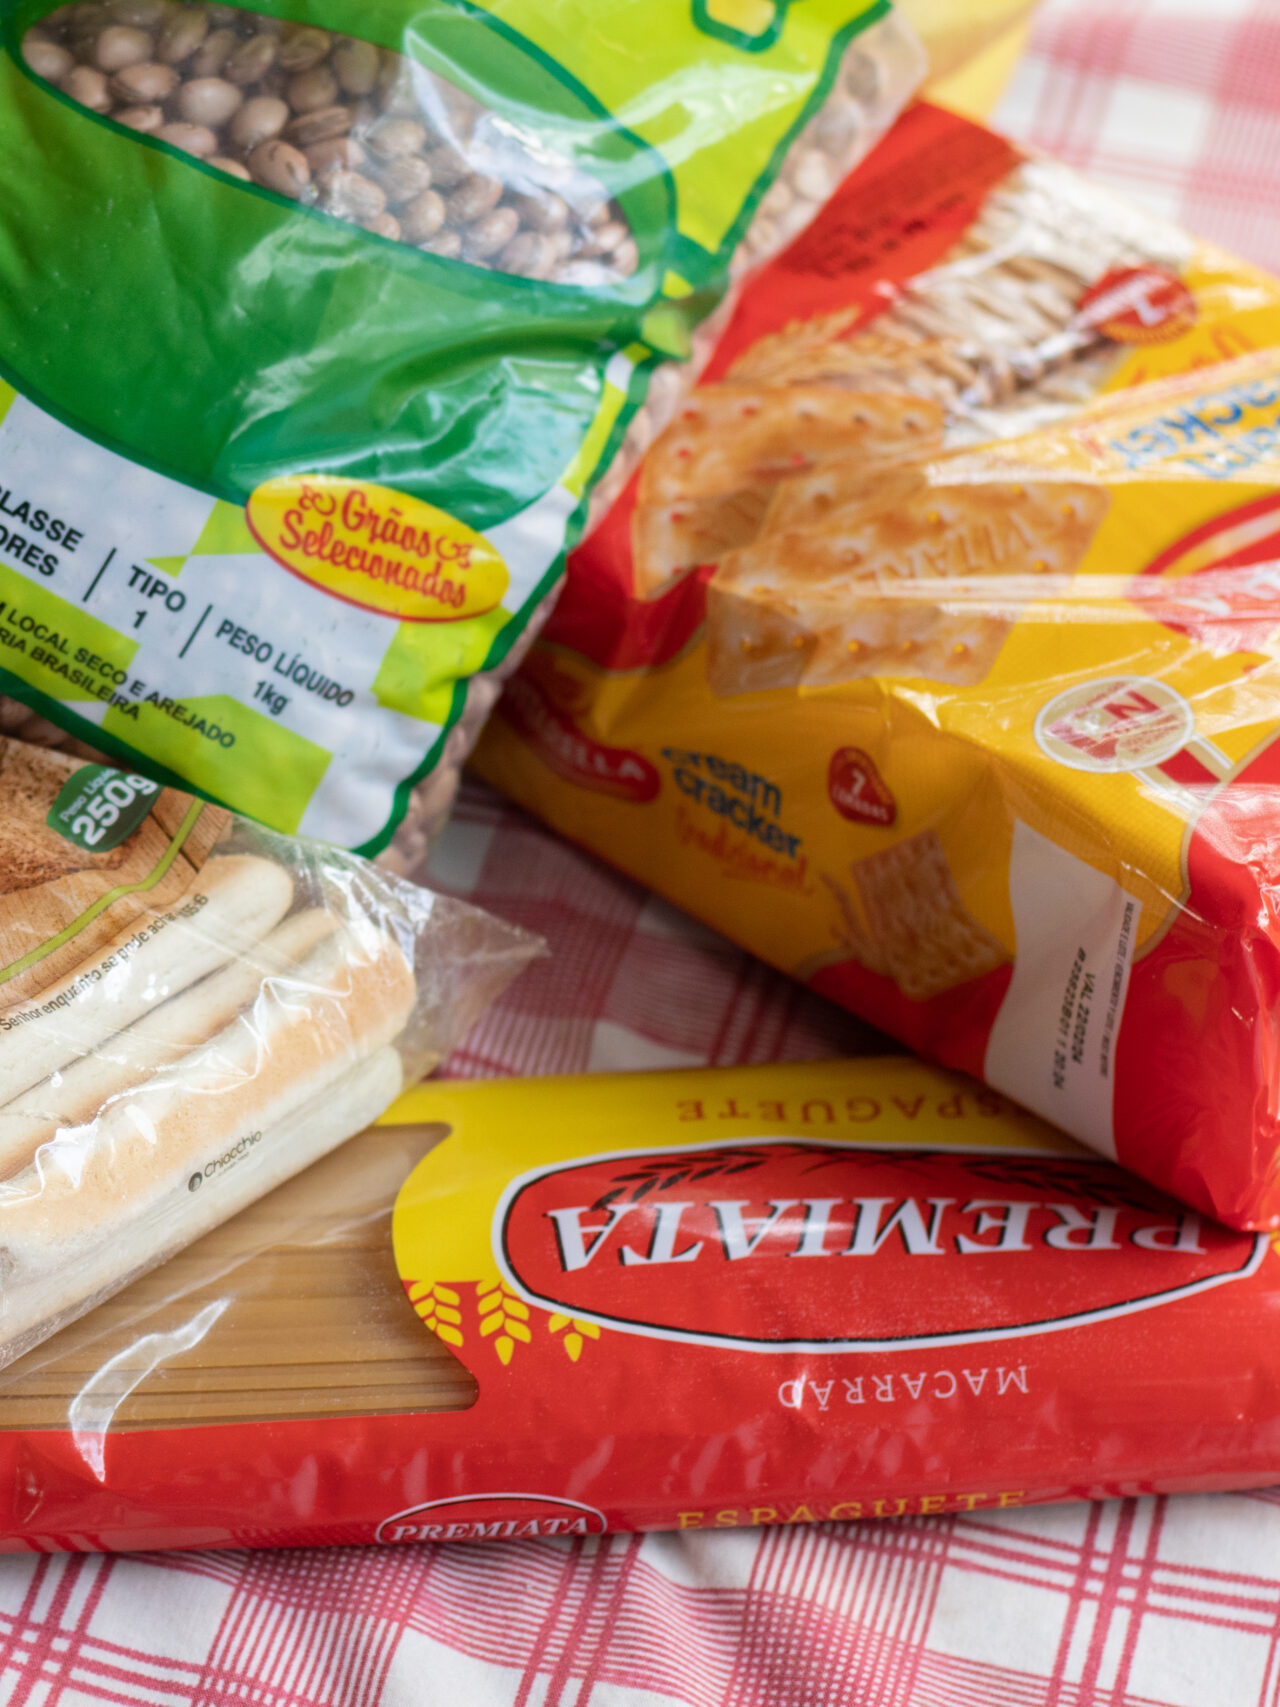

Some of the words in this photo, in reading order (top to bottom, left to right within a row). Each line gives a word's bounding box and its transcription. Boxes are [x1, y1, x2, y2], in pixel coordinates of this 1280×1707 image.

[341, 489, 431, 558] Grãos
[128, 565, 186, 612] TIPO
[279, 509, 466, 609] Selecionados
[133, 610, 148, 629] 1
[7, 609, 70, 655] LOCAL
[73, 647, 128, 685] SECO
[129, 679, 146, 697] E
[144, 691, 236, 749] AREJADO
[29, 646, 140, 721] BRASILEIRA
[215, 619, 273, 663] PESO
[273, 652, 355, 707] LÍQUIDO
[253, 680, 290, 716] 1kg
[72, 774, 158, 846] 250g
[673, 767, 805, 859] cracker
[43, 969, 103, 1016] enquanto
[101, 955, 119, 973] se
[117, 931, 150, 962] pode
[1080, 972, 1096, 1001] VAL
[675, 1091, 1012, 1125] SPAGUETE
[204, 1130, 263, 1178] Chiacchio
[546, 1198, 1208, 1273] PREMIATA
[777, 1364, 1030, 1413] MACARRÃO
[391, 1515, 590, 1542] PREMIATA
[677, 1491, 1026, 1530] ESPAGUETE
